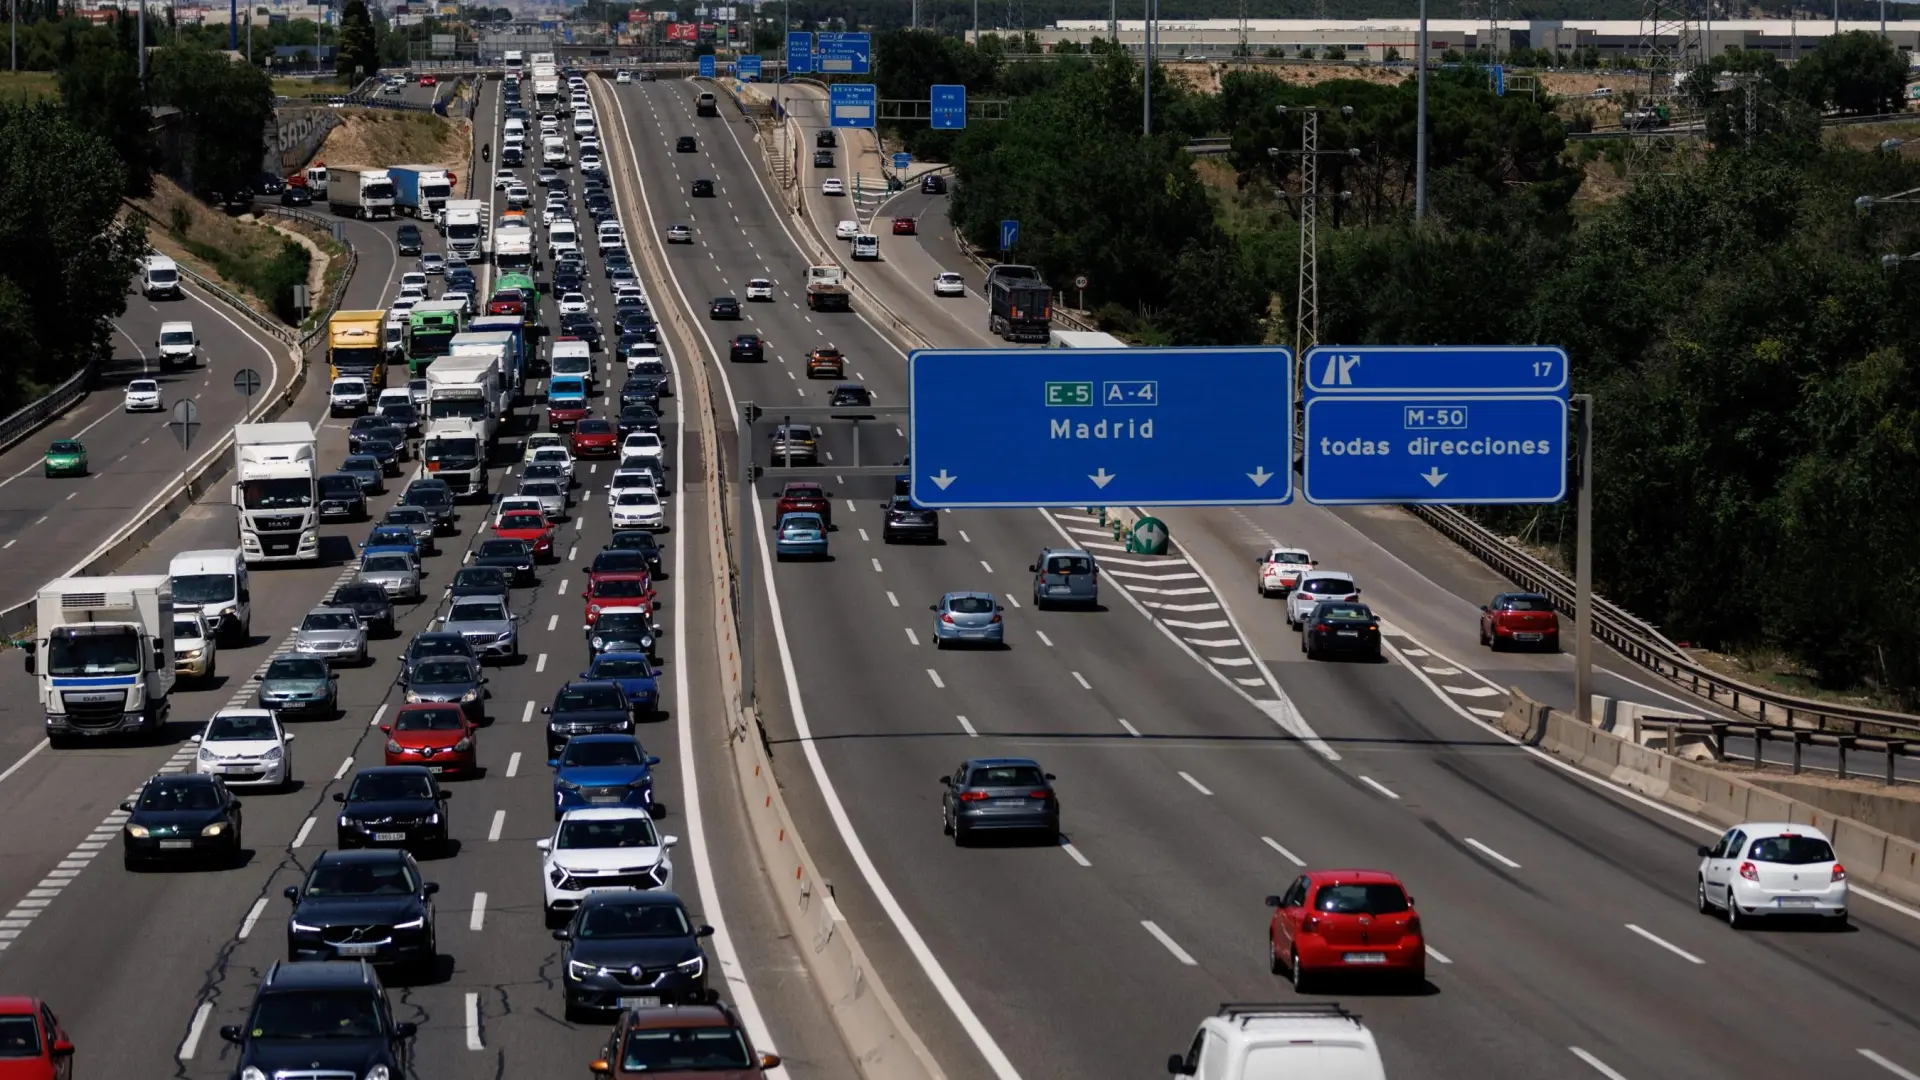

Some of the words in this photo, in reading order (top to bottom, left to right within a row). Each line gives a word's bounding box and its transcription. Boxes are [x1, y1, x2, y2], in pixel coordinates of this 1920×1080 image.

[1532, 362, 1553, 377] 17
[1049, 385, 1089, 402] E-5
[1107, 384, 1153, 401] A-4
[1407, 409, 1464, 426] M-50
[1050, 418, 1154, 439] Madrid
[1320, 437, 1391, 456] todas
[1407, 437, 1550, 456] direcciones
